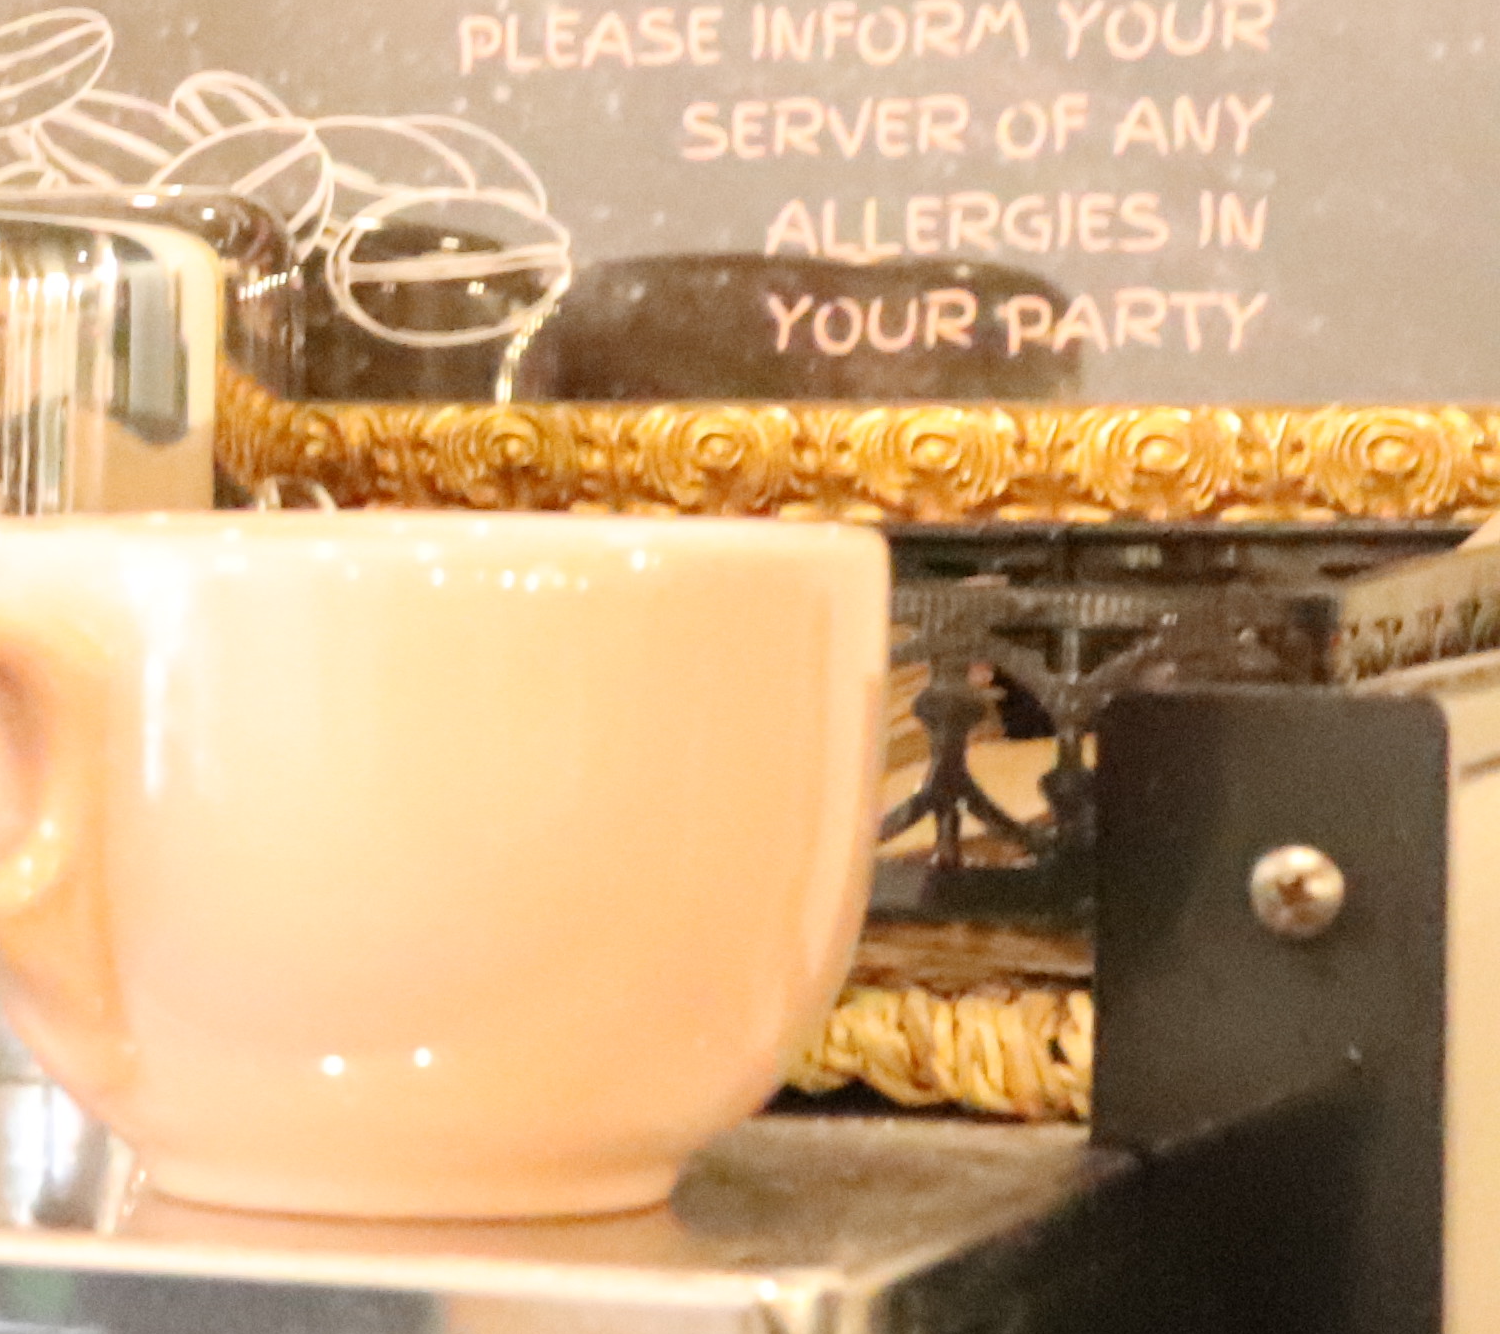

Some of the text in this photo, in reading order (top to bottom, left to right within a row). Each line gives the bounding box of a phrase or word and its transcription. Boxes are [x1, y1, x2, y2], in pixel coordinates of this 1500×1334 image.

[456, 6, 723, 74] PLEASE
[680, 91, 1275, 161] SERVER OF ANY
[764, 188, 1268, 264] ALLERGIES IN
[767, 287, 1268, 356] YOUR PARTY
